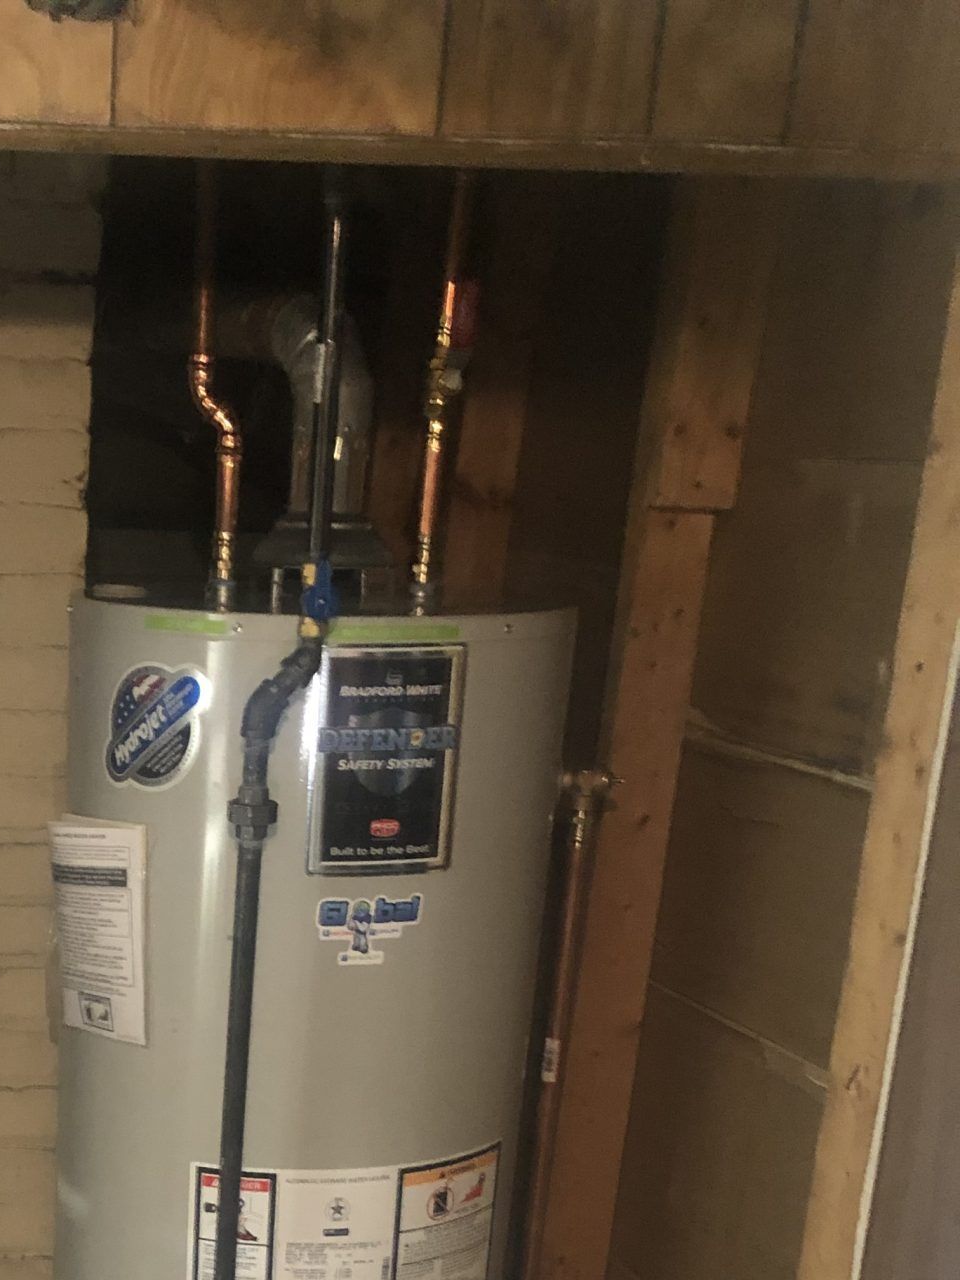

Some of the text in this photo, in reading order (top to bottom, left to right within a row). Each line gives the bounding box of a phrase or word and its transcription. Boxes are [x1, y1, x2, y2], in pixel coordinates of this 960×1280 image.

[339, 685, 442, 697] BRADFORD WHITE
[114, 704, 167, 766] Hydrojet
[318, 727, 456, 753] DEFENDER
[337, 757, 435, 771] SAFETY SYSTEM
[330, 846, 354, 856] Built
[356, 846, 368, 855] to
[370, 846, 384, 855] be
[386, 845, 404, 855] the
